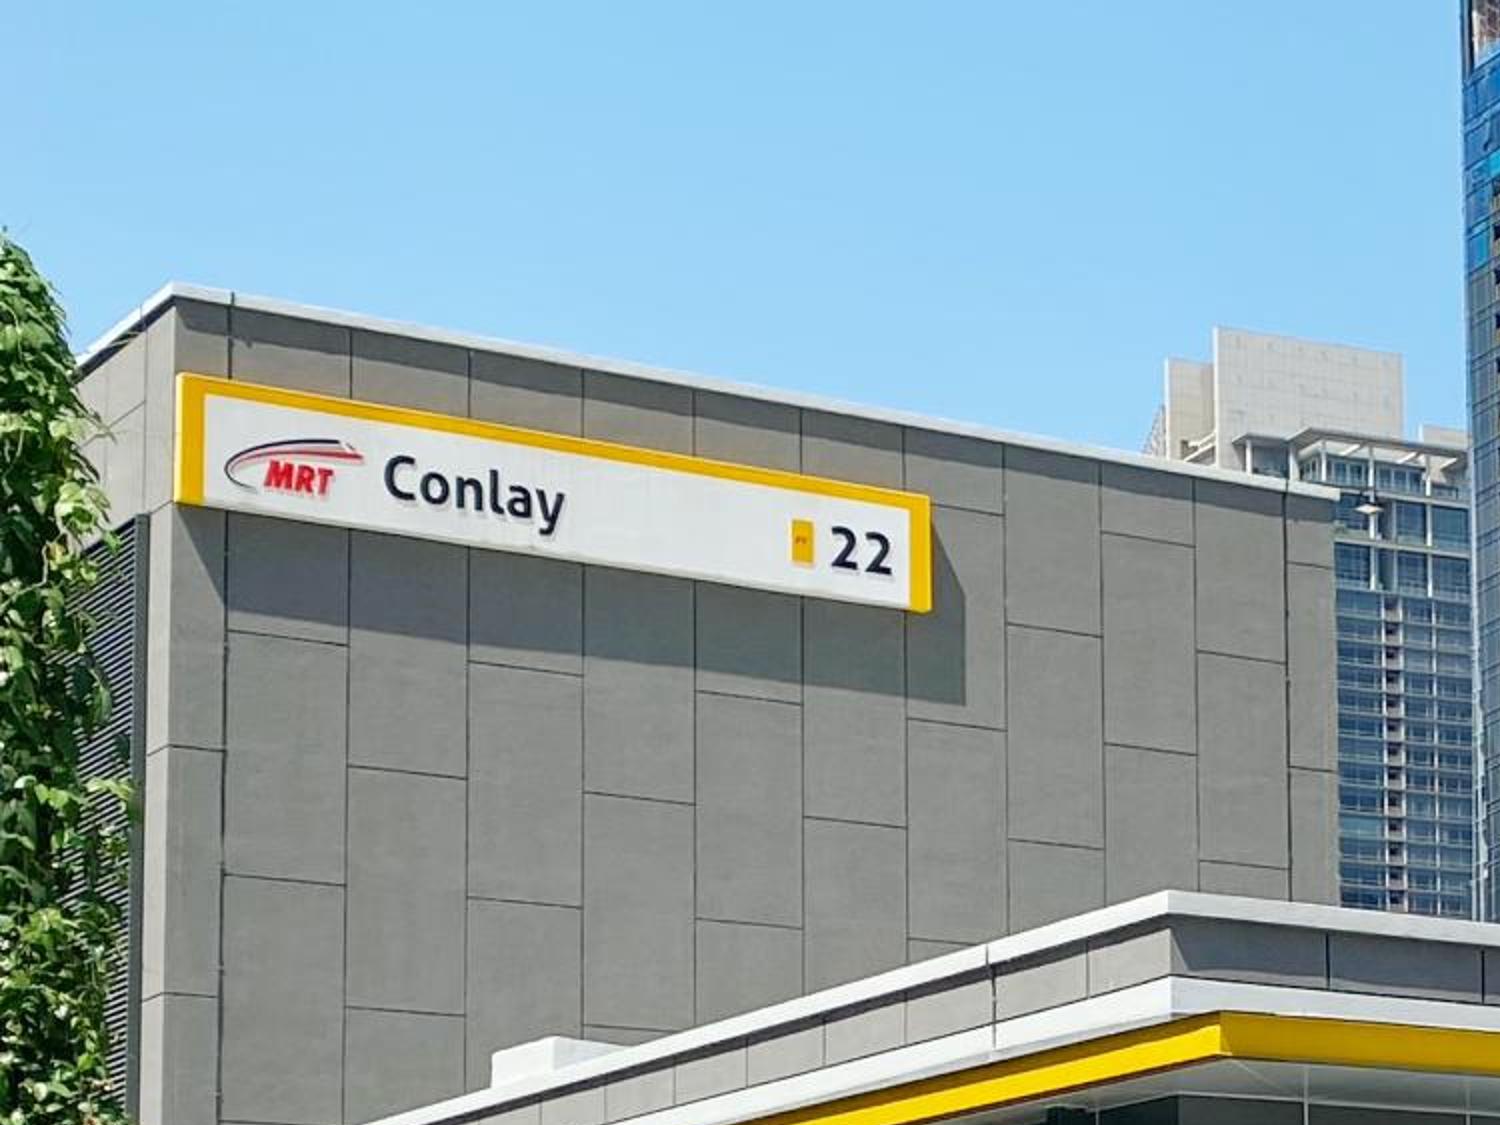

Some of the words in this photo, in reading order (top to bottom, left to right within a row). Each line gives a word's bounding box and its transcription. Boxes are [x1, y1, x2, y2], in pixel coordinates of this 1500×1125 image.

[264, 459, 334, 495] MRT
[384, 455, 565, 535] Conlay
[831, 526, 892, 575] 22
